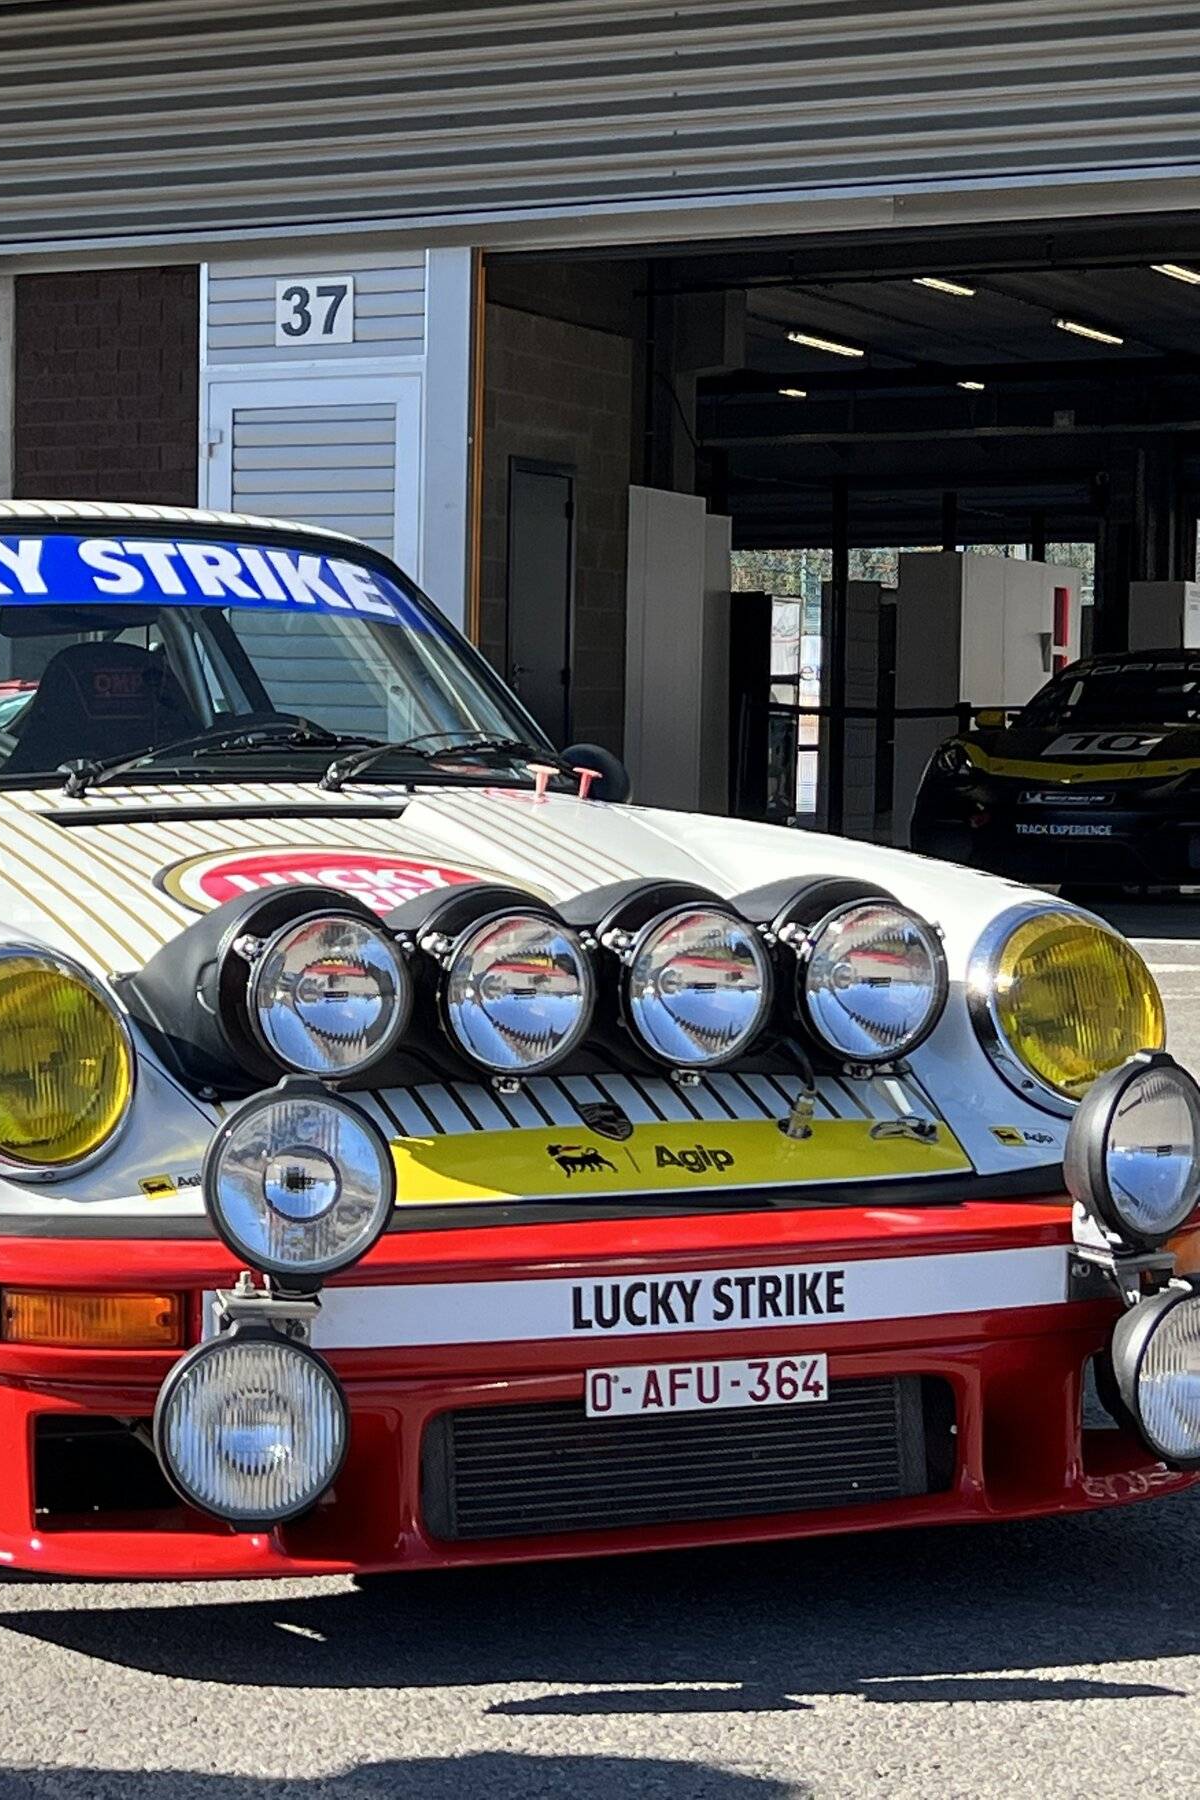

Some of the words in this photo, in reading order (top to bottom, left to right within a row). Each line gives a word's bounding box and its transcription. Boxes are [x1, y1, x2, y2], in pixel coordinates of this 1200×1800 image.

[281, 285, 348, 337] 37
[78, 540, 396, 618] STRIKE
[1016, 824, 1048, 835] TRACK
[1050, 825, 1112, 836] EXPERIENCE
[654, 1144, 735, 1173] Agip
[572, 1279, 703, 1330] LUCKY
[712, 1270, 846, 1322] STRIKE
